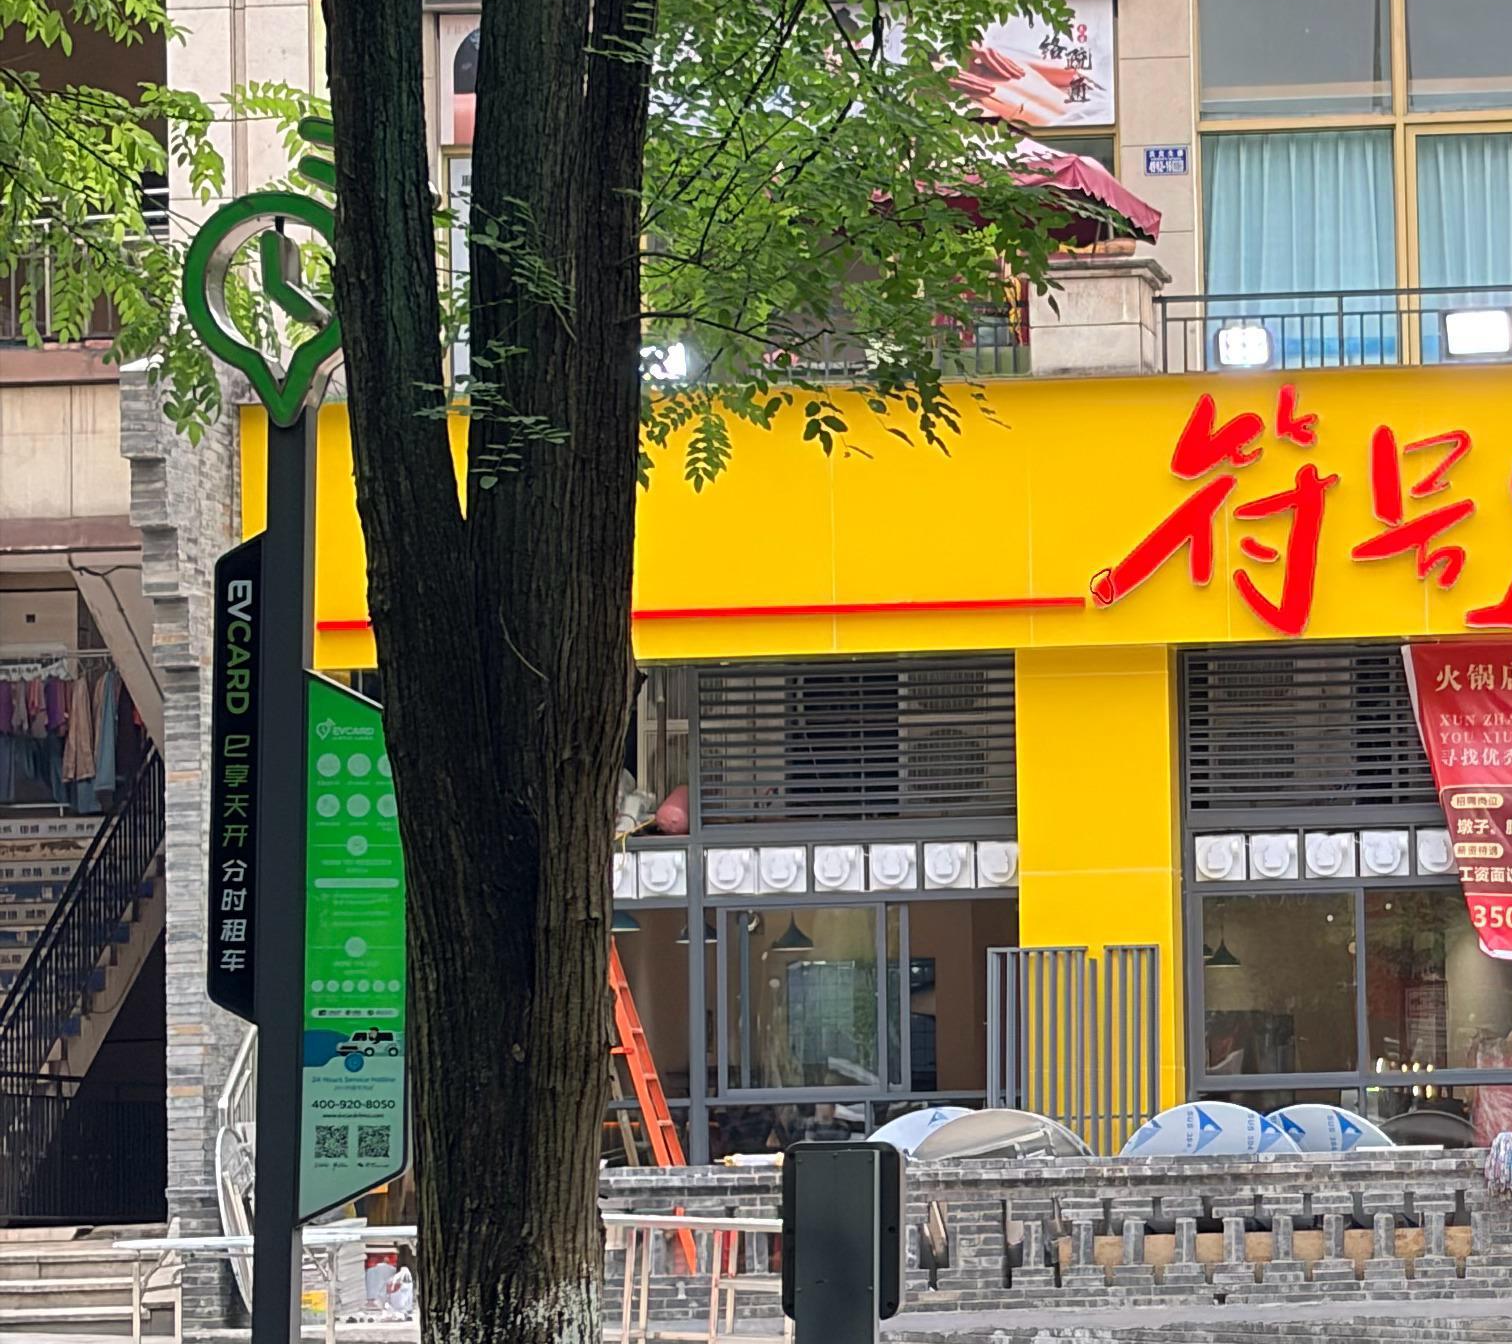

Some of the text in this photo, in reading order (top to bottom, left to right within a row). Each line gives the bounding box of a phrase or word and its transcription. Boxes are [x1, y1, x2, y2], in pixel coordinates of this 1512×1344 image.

[226, 579, 253, 715] EVCARD
[1439, 713, 1476, 727] XUN
[1439, 731, 1475, 744] YOU
